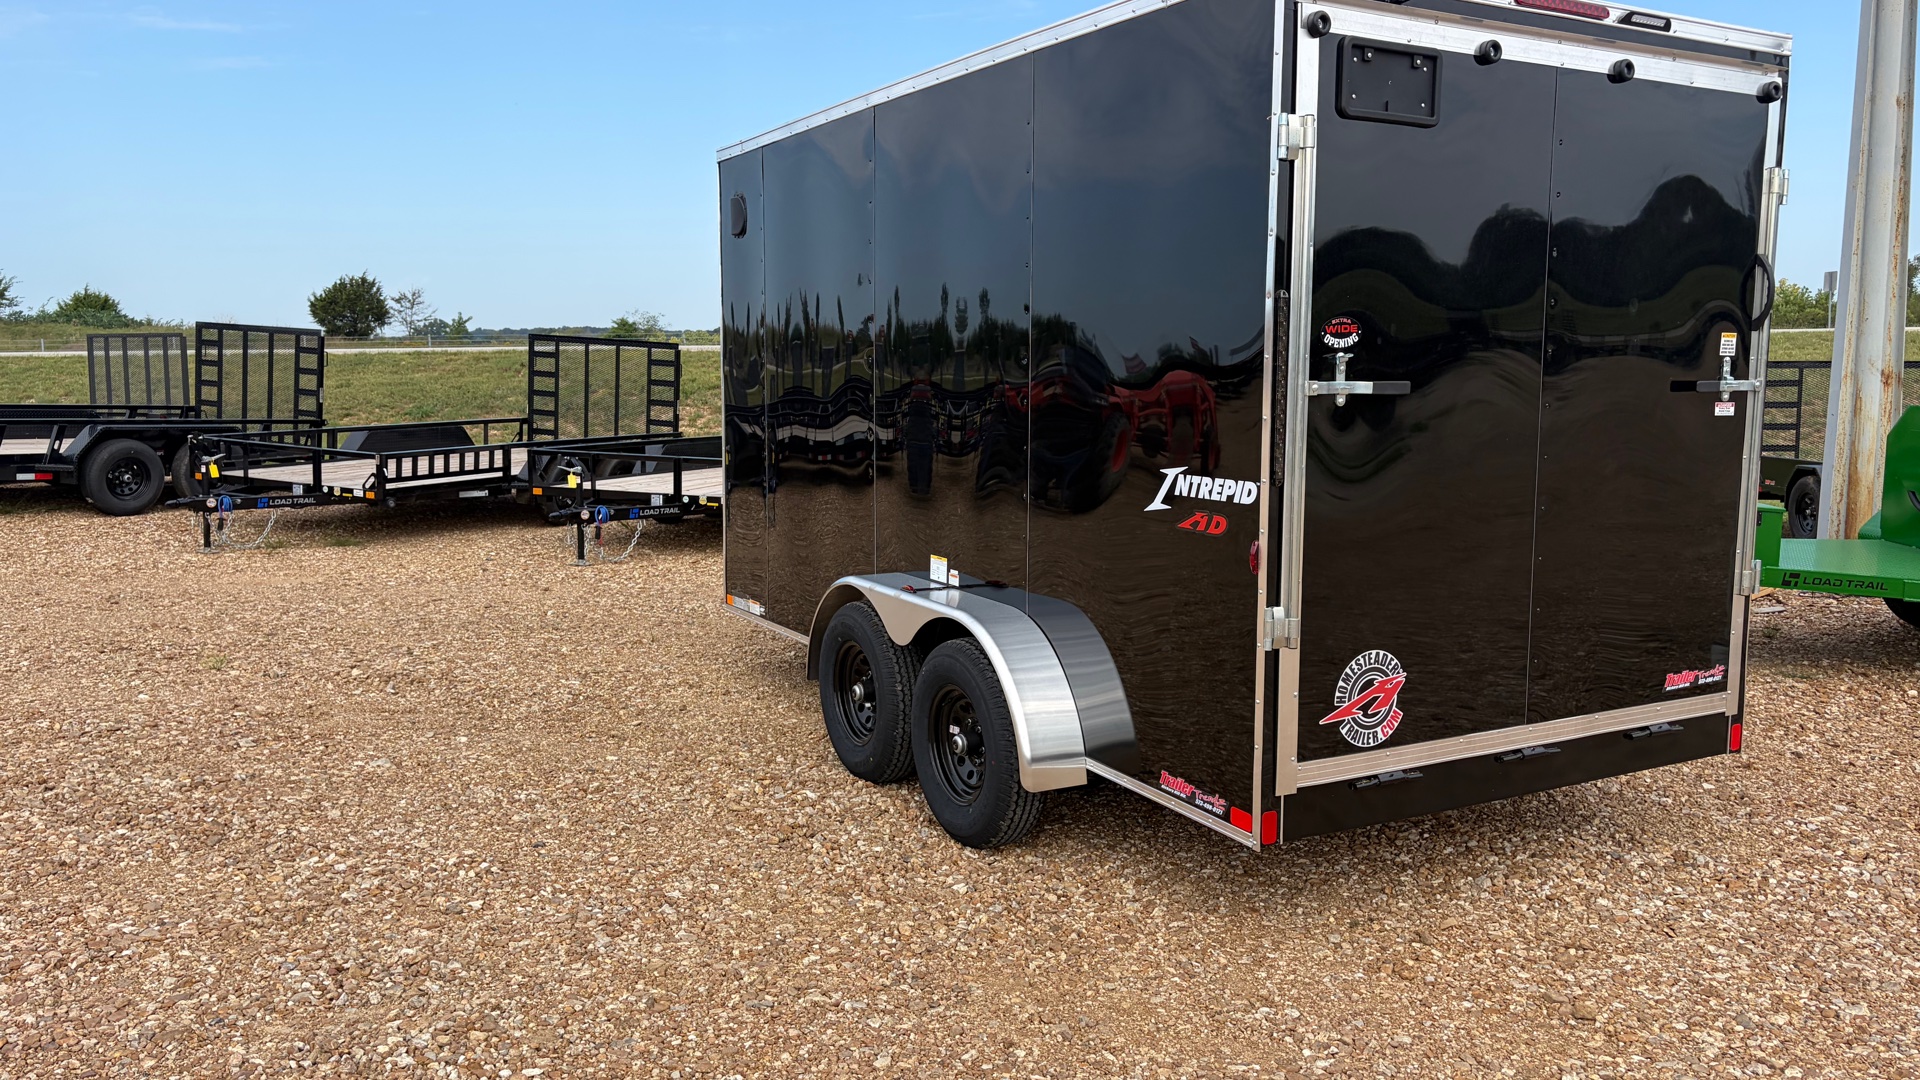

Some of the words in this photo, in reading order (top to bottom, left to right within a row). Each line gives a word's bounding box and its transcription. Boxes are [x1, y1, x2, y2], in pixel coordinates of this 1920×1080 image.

[1325, 324, 1359, 334] WIDE
[1323, 333, 1359, 348] OPENING
[269, 498, 292, 506] LOAD
[293, 497, 317, 505] TRAIL
[639, 508, 660, 516] LOAD
[660, 506, 681, 515] TRAIL
[1803, 576, 1843, 587] LOAD
[1846, 579, 1889, 591] TRAIL
[1335, 651, 1401, 705] HOMESTEADER
[1664, 669, 1698, 687] Trailer
[1159, 770, 1194, 797] Trailer
